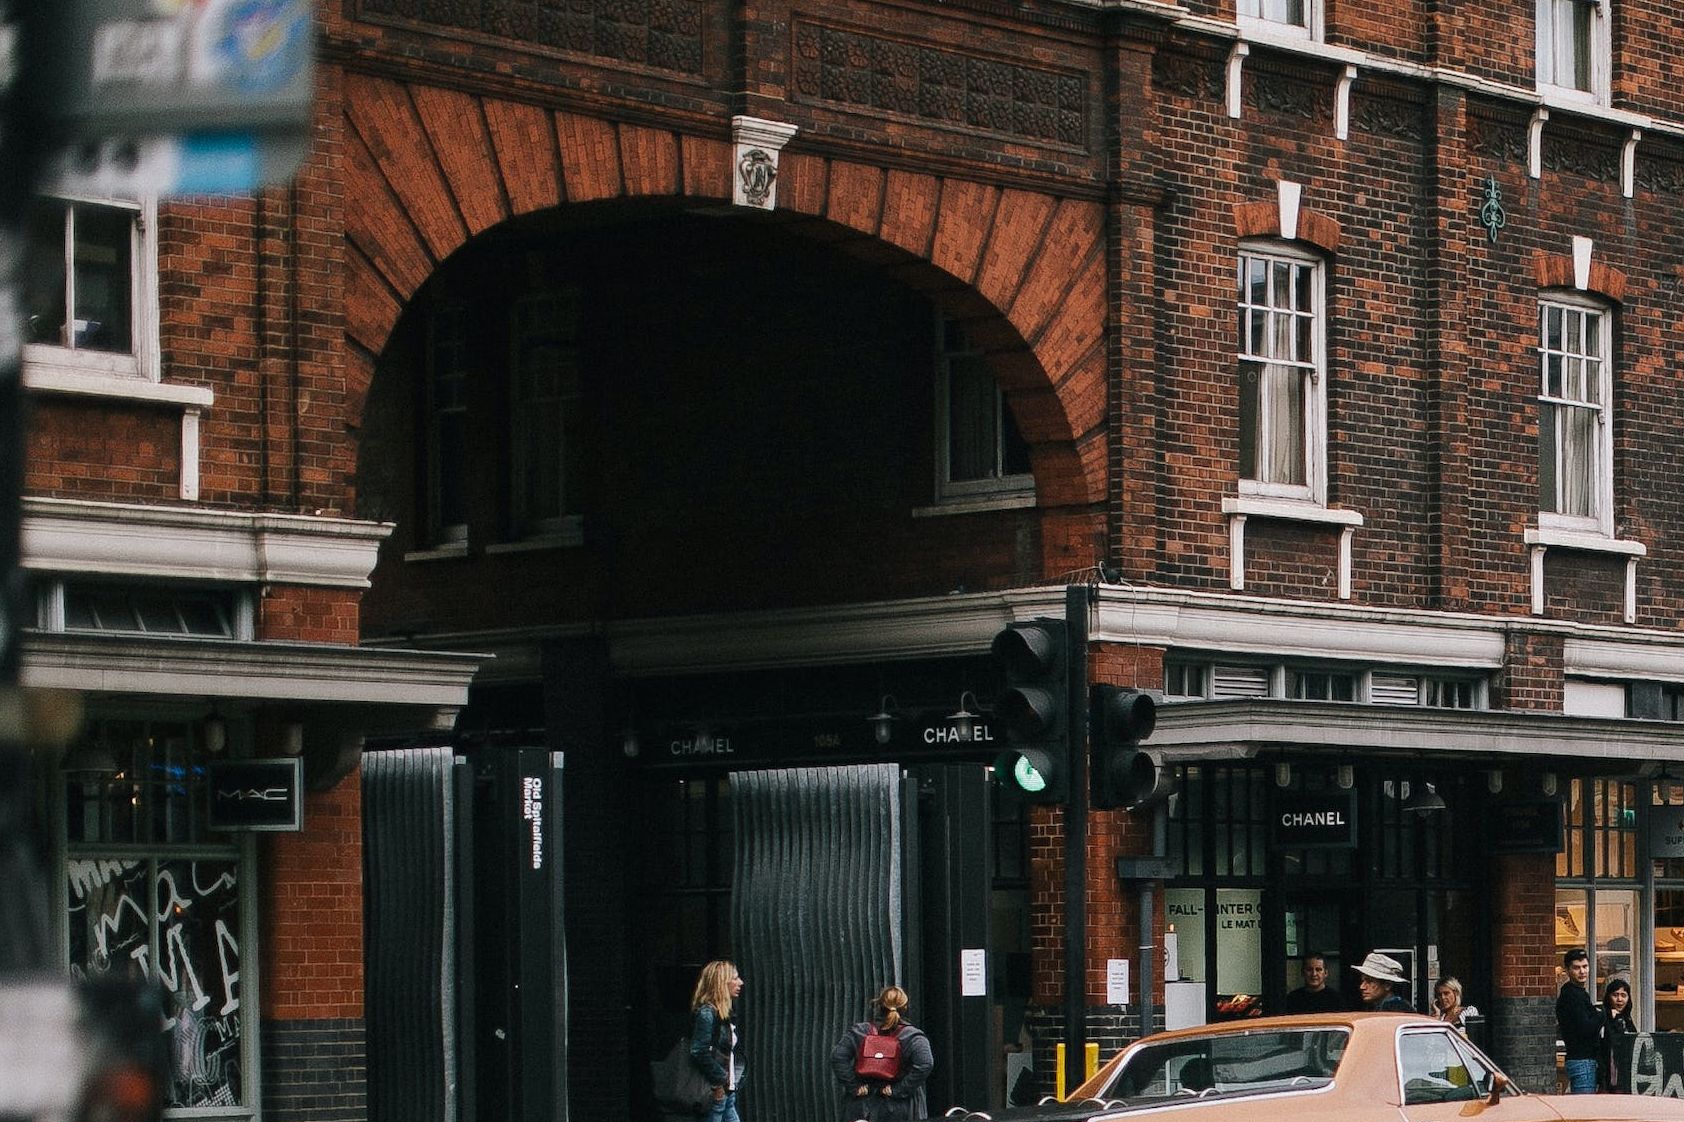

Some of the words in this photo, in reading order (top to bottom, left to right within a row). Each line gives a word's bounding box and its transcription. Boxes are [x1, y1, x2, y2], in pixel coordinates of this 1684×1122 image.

[923, 725, 994, 744] CHAEL
[523, 777, 533, 820] Market
[532, 777, 542, 800] Old
[1282, 811, 1345, 827] CHANEL
[531, 801, 543, 870] Spitalfields
[1222, 920, 1233, 929] LE
[1235, 919, 1256, 929] MAT
